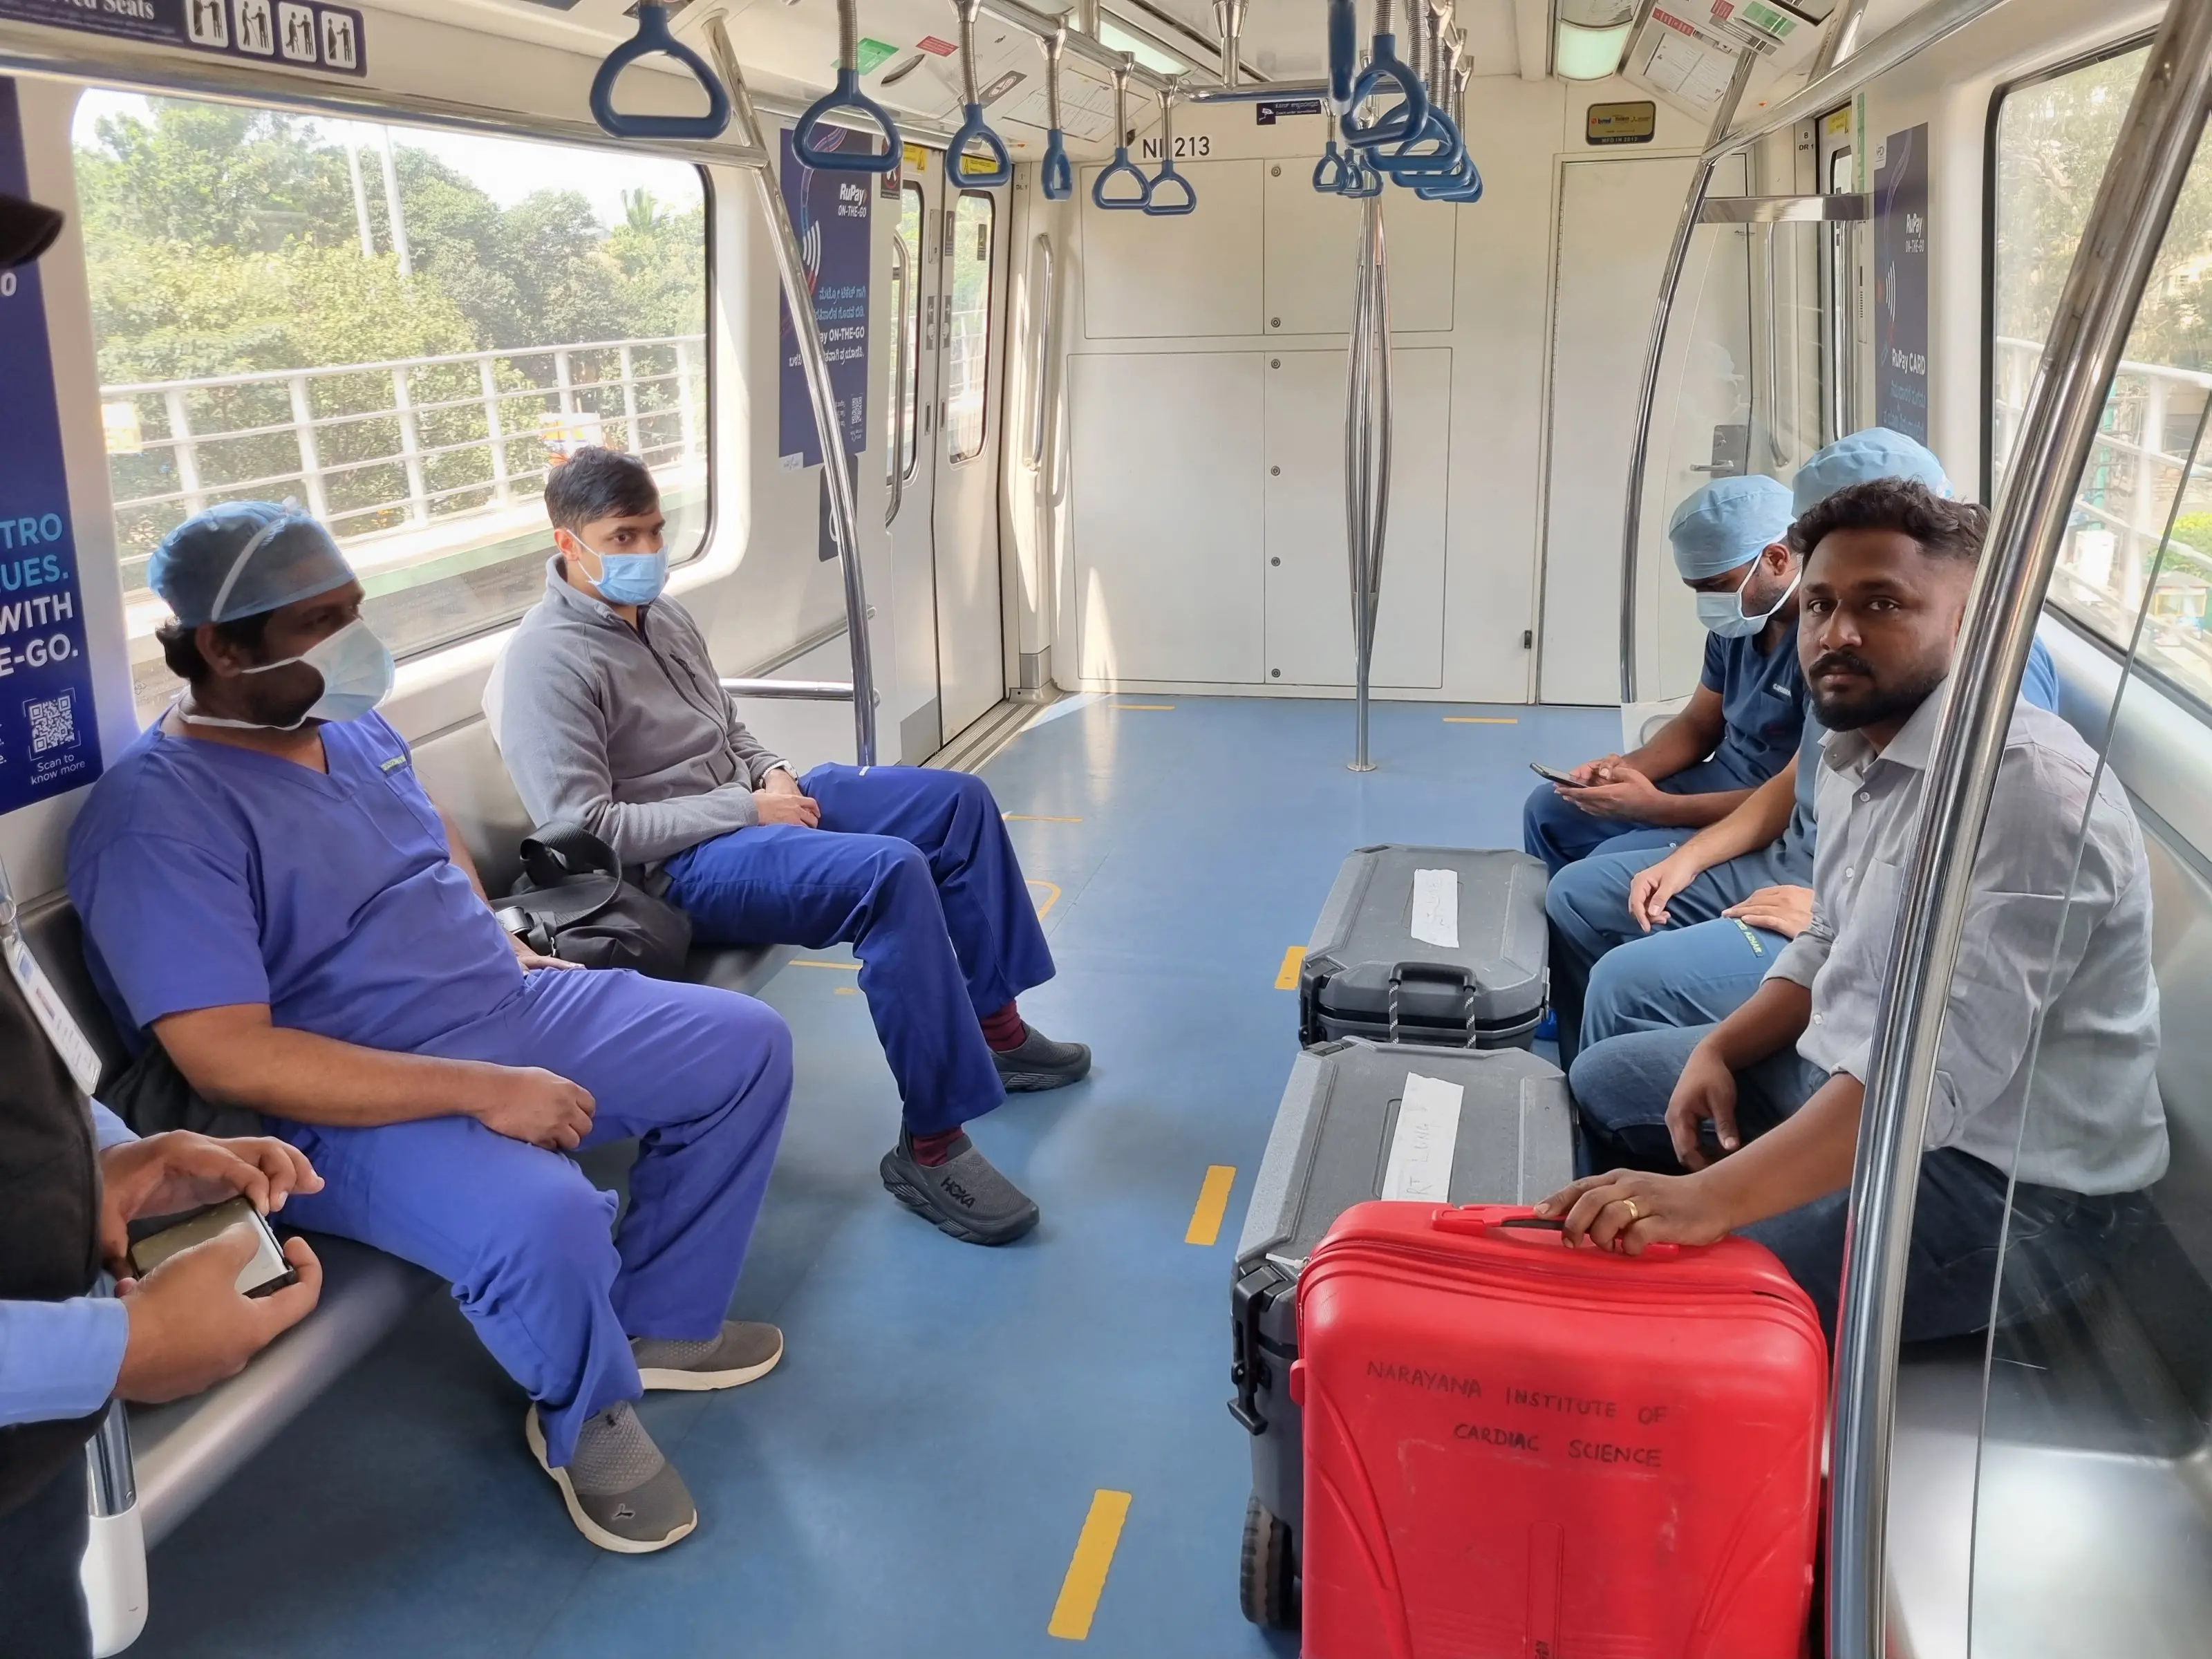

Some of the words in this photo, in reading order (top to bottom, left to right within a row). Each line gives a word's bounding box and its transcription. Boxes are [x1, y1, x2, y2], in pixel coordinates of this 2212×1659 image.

[839, 183, 865, 206] RuPay
[838, 205, 867, 218] ON-THE-GO
[1906, 213, 1923, 238] RuPay
[1905, 238, 1925, 253] ON-THE-GO
[829, 326, 865, 342] ON-THE-GO
[1891, 347, 1908, 375] RuPay
[1909, 351, 1926, 375] CARD
[0, 554, 69, 592] UES.
[0, 592, 73, 635] WITH
[31, 769, 58, 785] know
[61, 761, 86, 776] more
[37, 758, 62, 772] Scan
[64, 754, 75, 763] to
[940, 1177, 976, 1209] HOKA
[1406, 1176, 1434, 1195] RT
[1366, 1360, 1481, 1398] NARAYANA
[1506, 1386, 1616, 1418] INSTITUTE
[1638, 1405, 1669, 1426] OF
[1453, 1423, 1540, 1452] CARDIAC
[1567, 1439, 1662, 1468] SCIENCE
